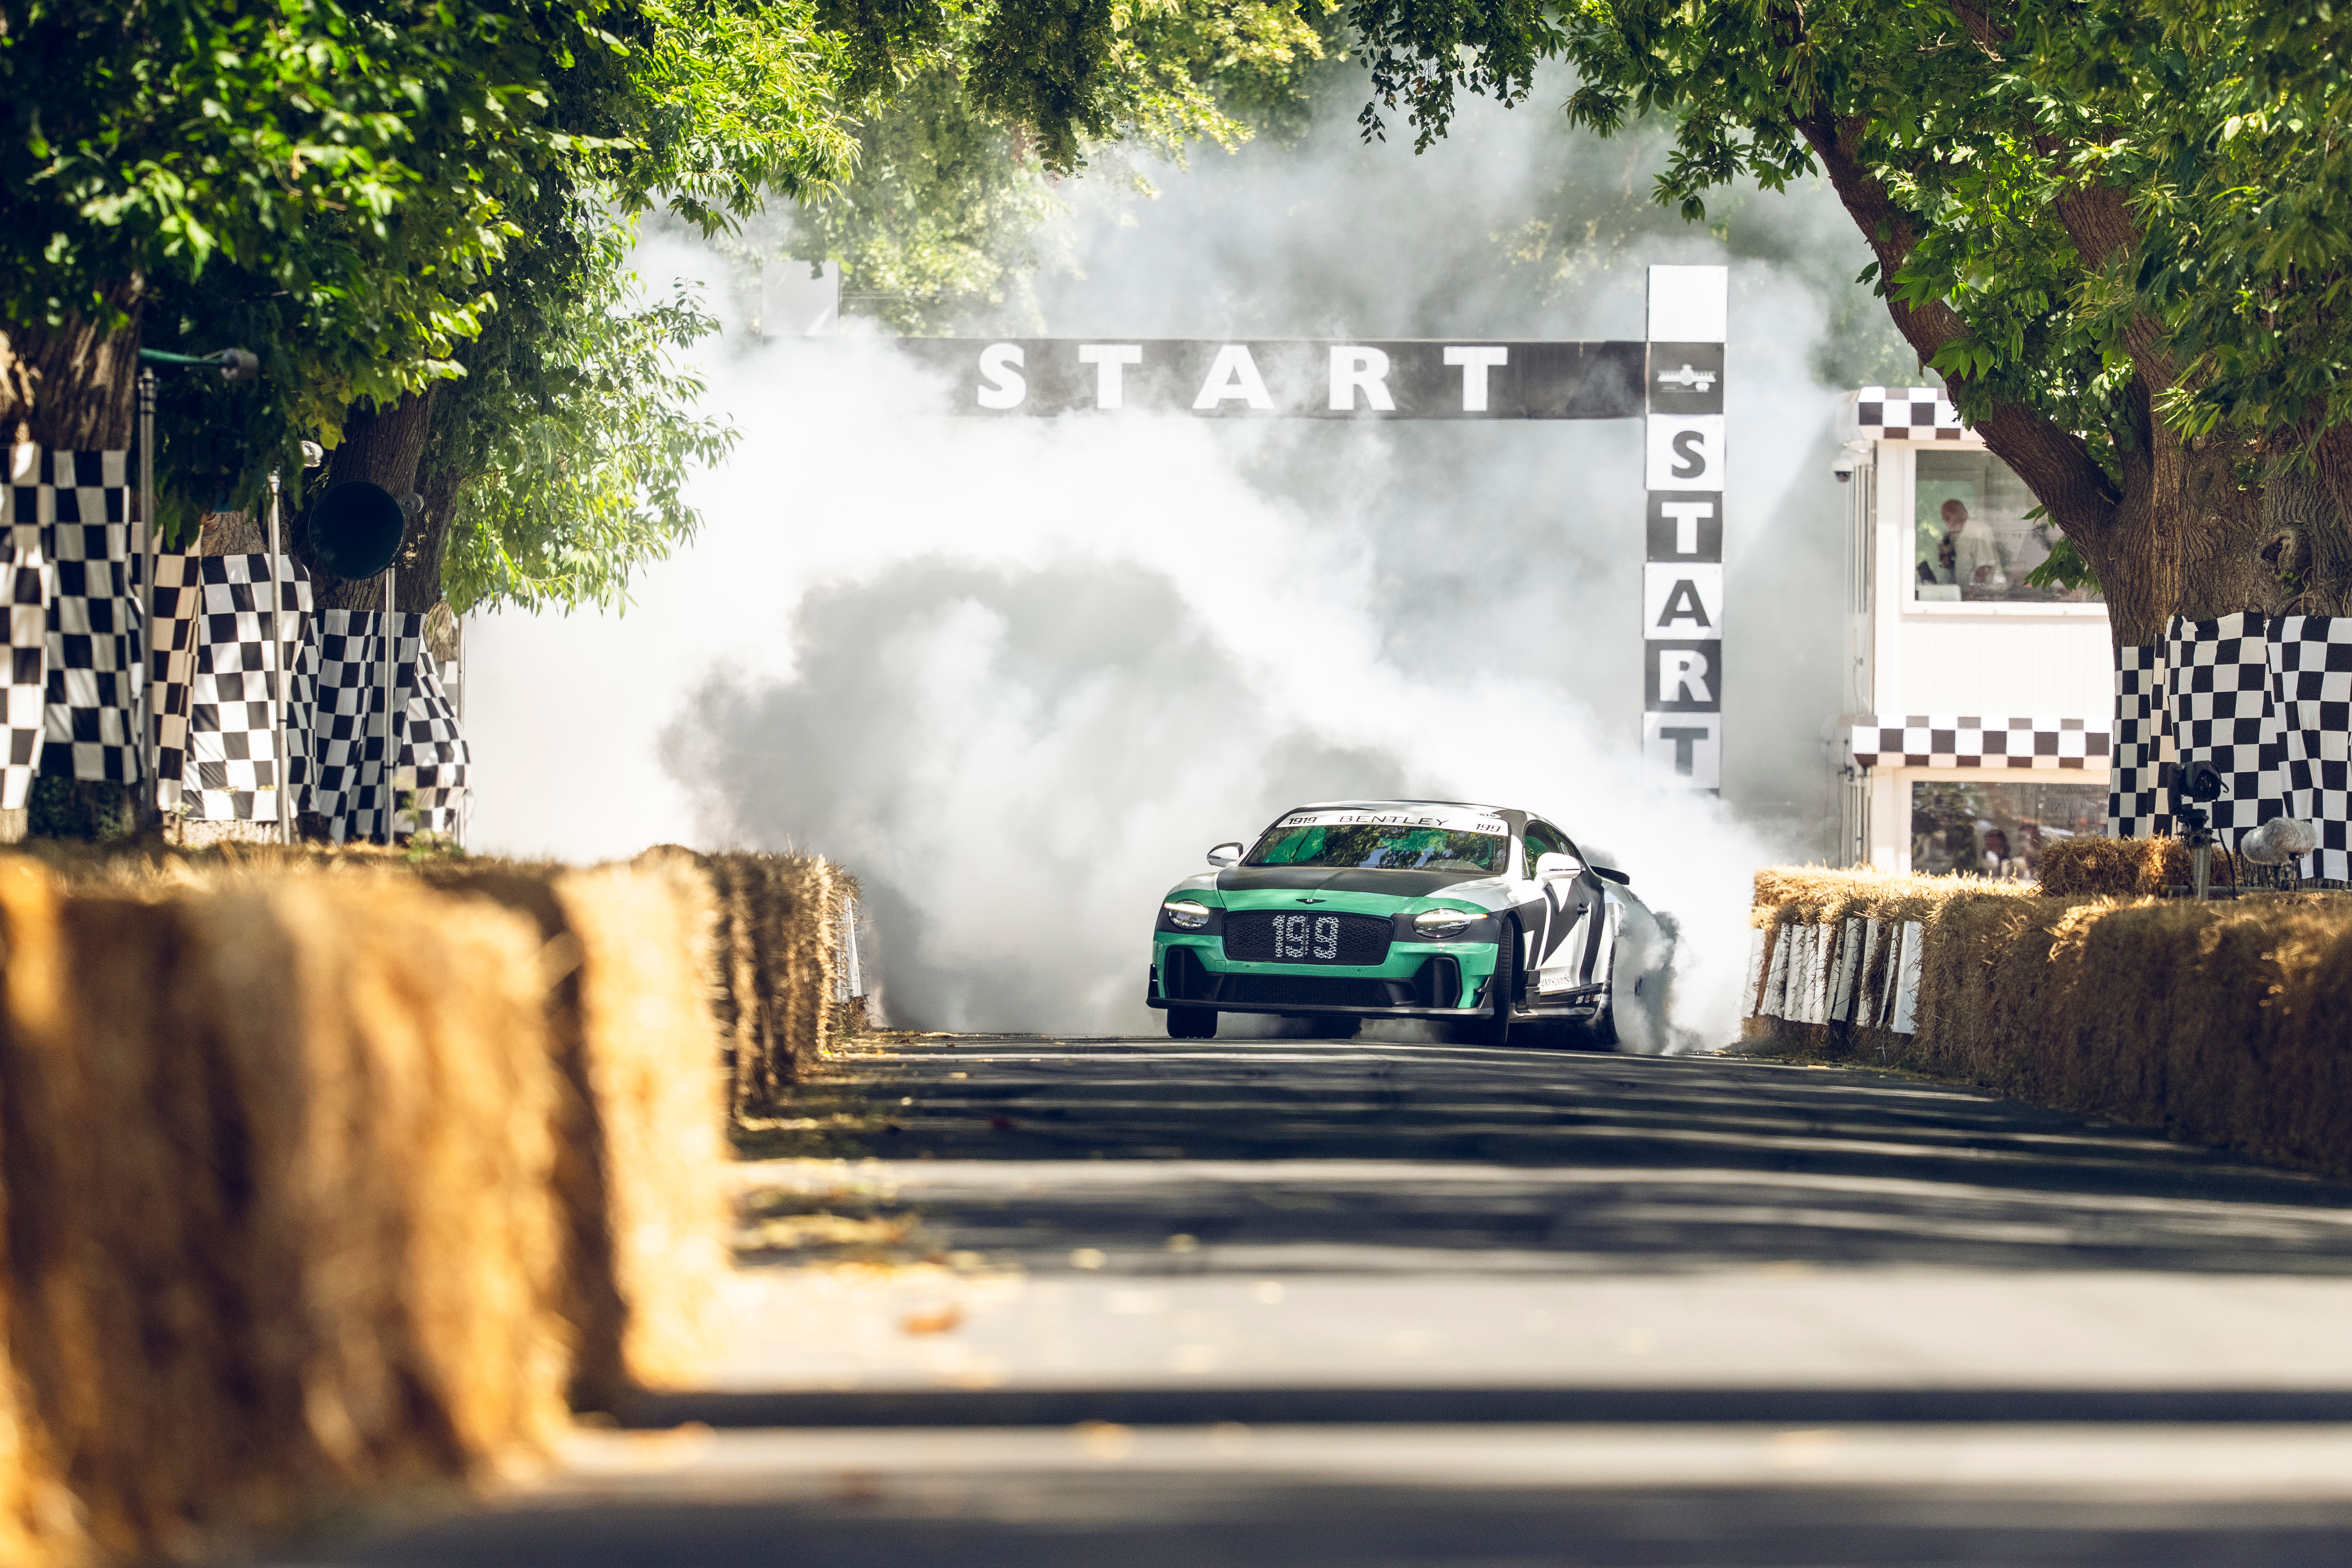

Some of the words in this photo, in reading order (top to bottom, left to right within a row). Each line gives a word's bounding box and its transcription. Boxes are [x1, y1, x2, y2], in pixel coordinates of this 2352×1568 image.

[977, 342, 1509, 412] START
[1656, 430, 1714, 776] START
[1339, 816, 1449, 826] BENTLEY
[1476, 824, 1501, 832] 199
[1273, 915, 1339, 959] 199
[1538, 974, 1569, 991] upersports
